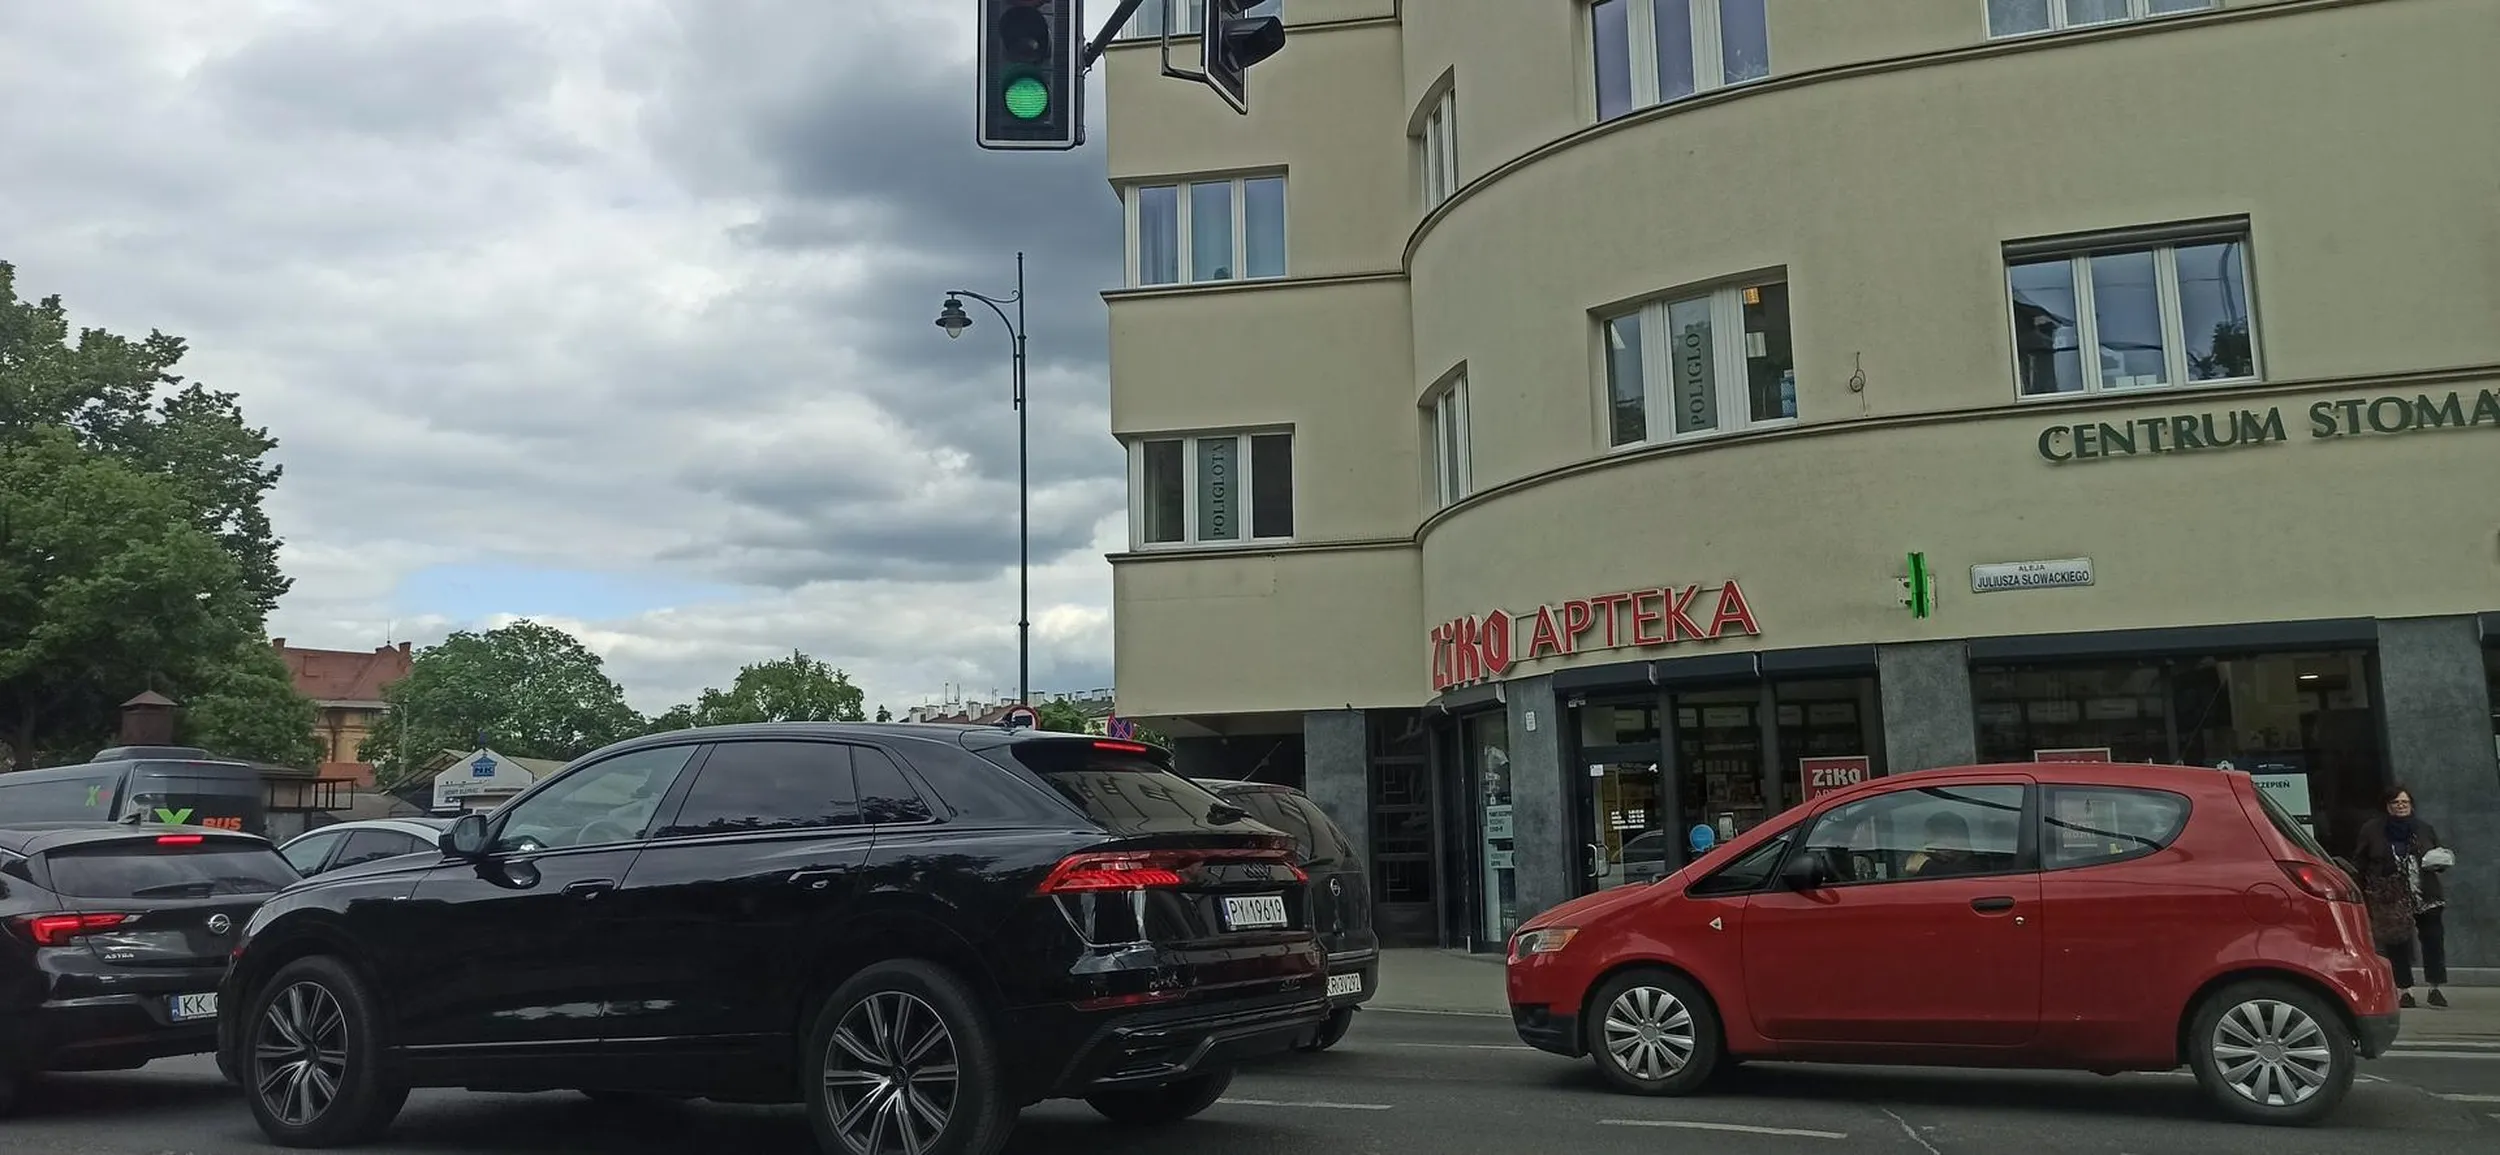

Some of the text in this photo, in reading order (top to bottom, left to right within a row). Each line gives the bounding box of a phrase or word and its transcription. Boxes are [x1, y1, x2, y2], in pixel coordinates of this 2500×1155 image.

[1685, 311, 1706, 426] POLIGLO
[2037, 388, 2500, 462] CENTRUM STOMA
[1212, 443, 1225, 536] POLIGLOTA
[1977, 570, 2090, 588] JULIUSZA SŁOWACKIEGO
[2018, 564, 2046, 572] ALEJA
[1528, 579, 1761, 657] APTEKA
[1229, 898, 1282, 923] PY 19619
[183, 995, 208, 1014] KK
